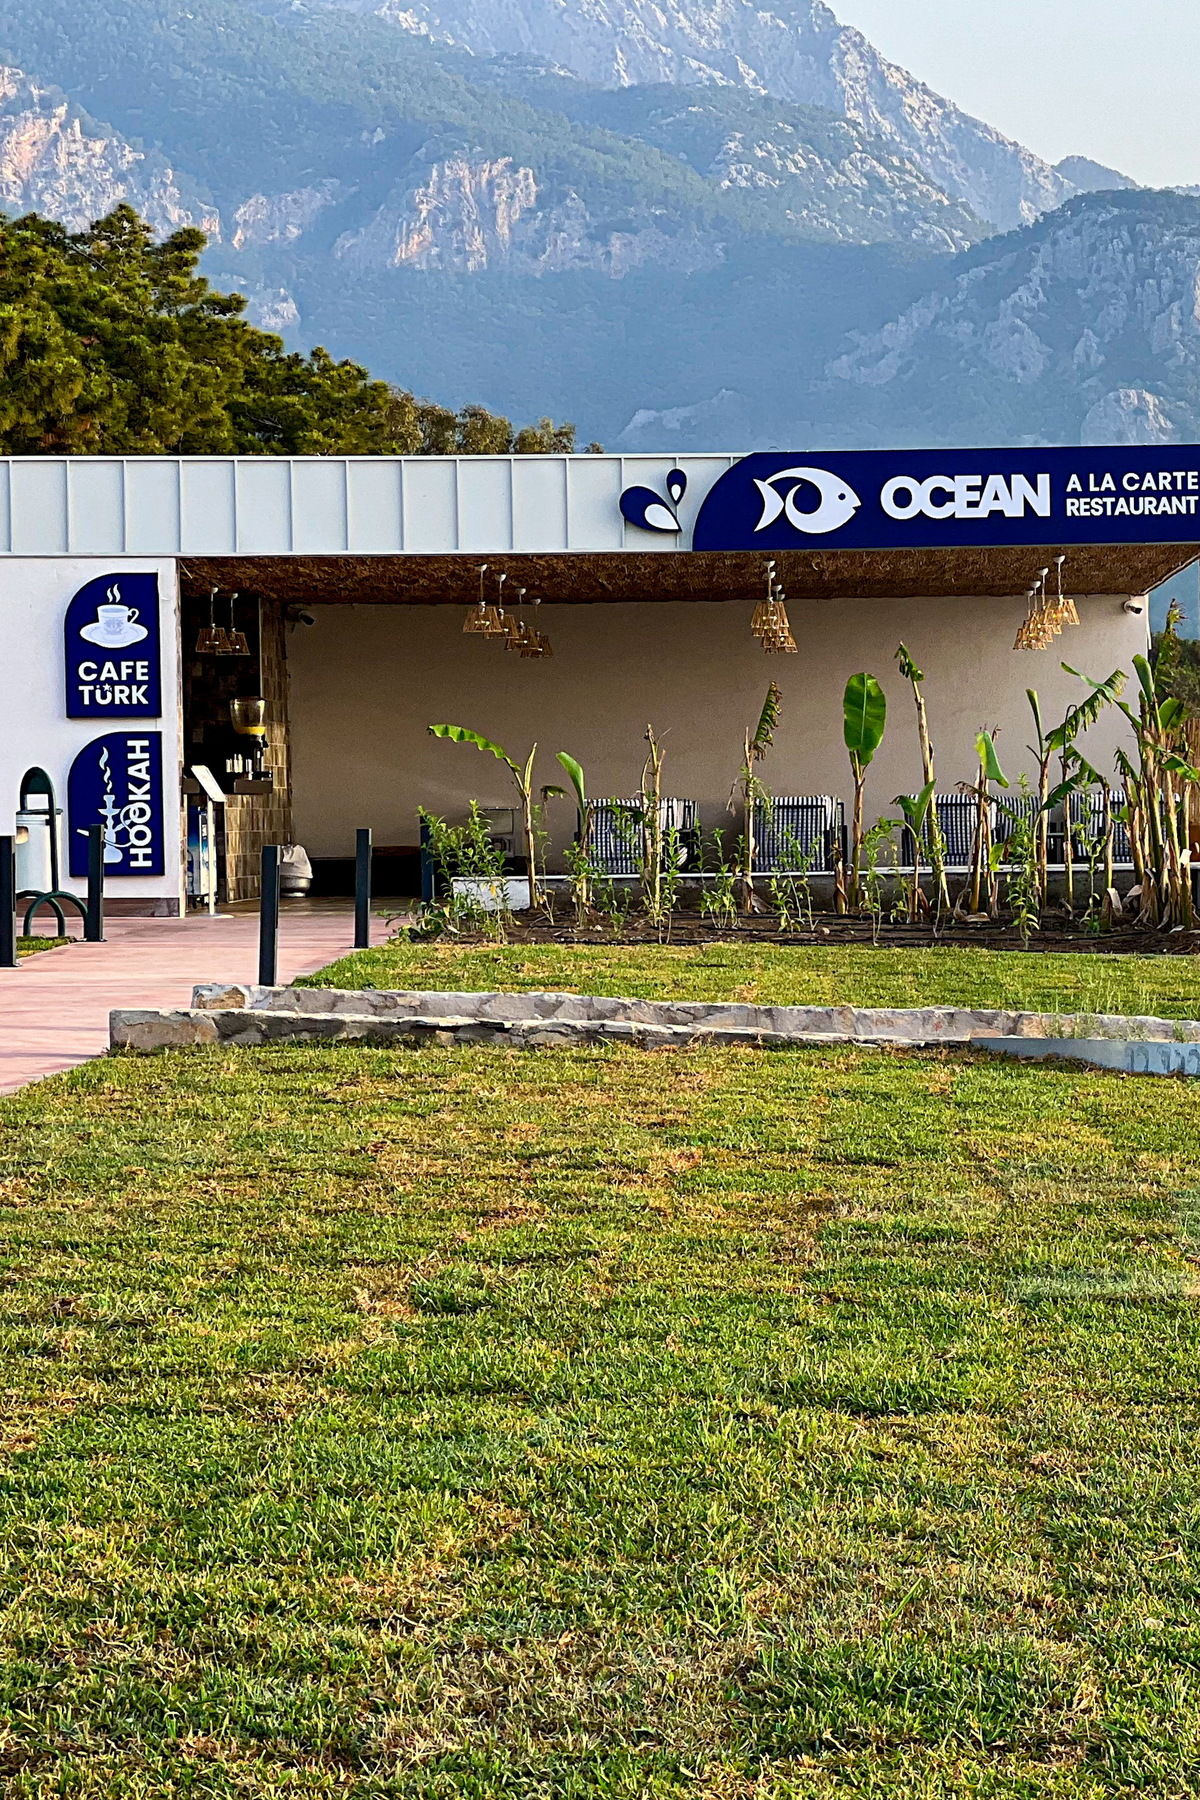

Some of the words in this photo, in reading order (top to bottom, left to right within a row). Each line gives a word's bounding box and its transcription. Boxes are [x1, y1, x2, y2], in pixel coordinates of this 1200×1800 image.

[1066, 473, 1083, 492] A
[1089, 472, 1117, 492] LA
[1122, 471, 1199, 491] CARTE
[880, 473, 1051, 520] OCEAN
[1066, 495, 1199, 517] RESTAURANT
[78, 660, 149, 682] CAFE
[127, 739, 153, 868] HOOKAH
